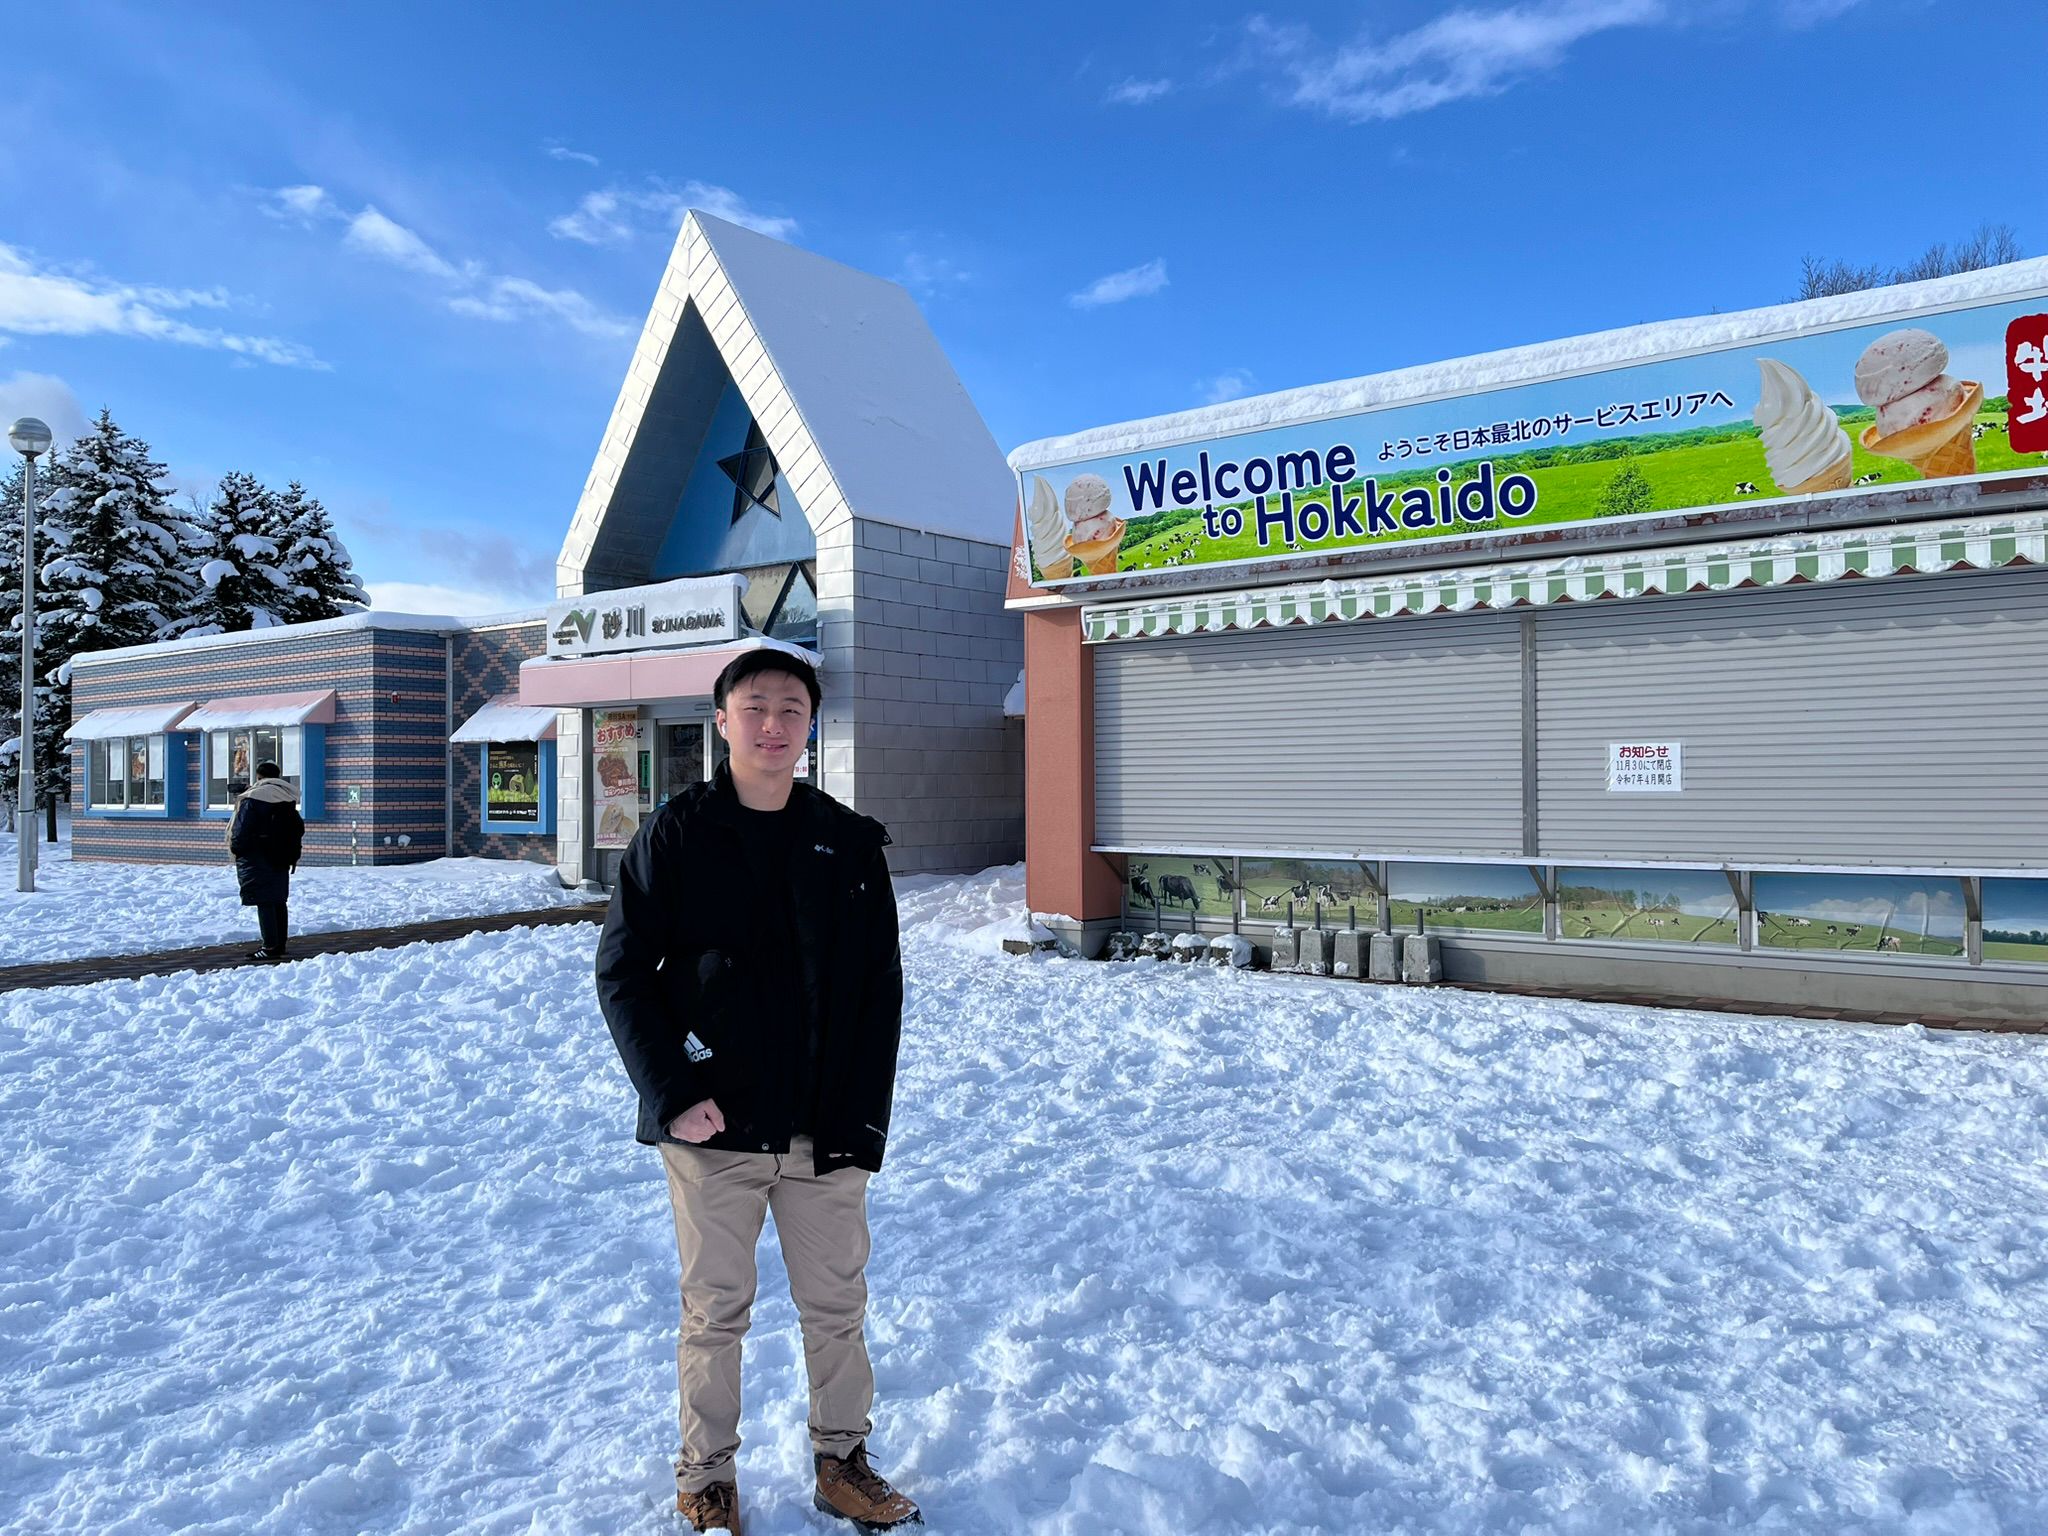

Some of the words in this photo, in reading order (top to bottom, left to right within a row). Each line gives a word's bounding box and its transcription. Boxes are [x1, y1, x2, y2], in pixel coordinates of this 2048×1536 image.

[1378, 391, 1734, 461] ようこそ日本最北のサービスエリアへ
[1122, 444, 1357, 512] Welcome
[1202, 503, 1243, 538] to
[1255, 462, 1537, 546] Hokkaido
[601, 603, 646, 640] 砂川
[651, 610, 726, 634] SUNAGAWA
[597, 721, 636, 744] おすすめ
[1619, 745, 1670, 758] お知らせ
